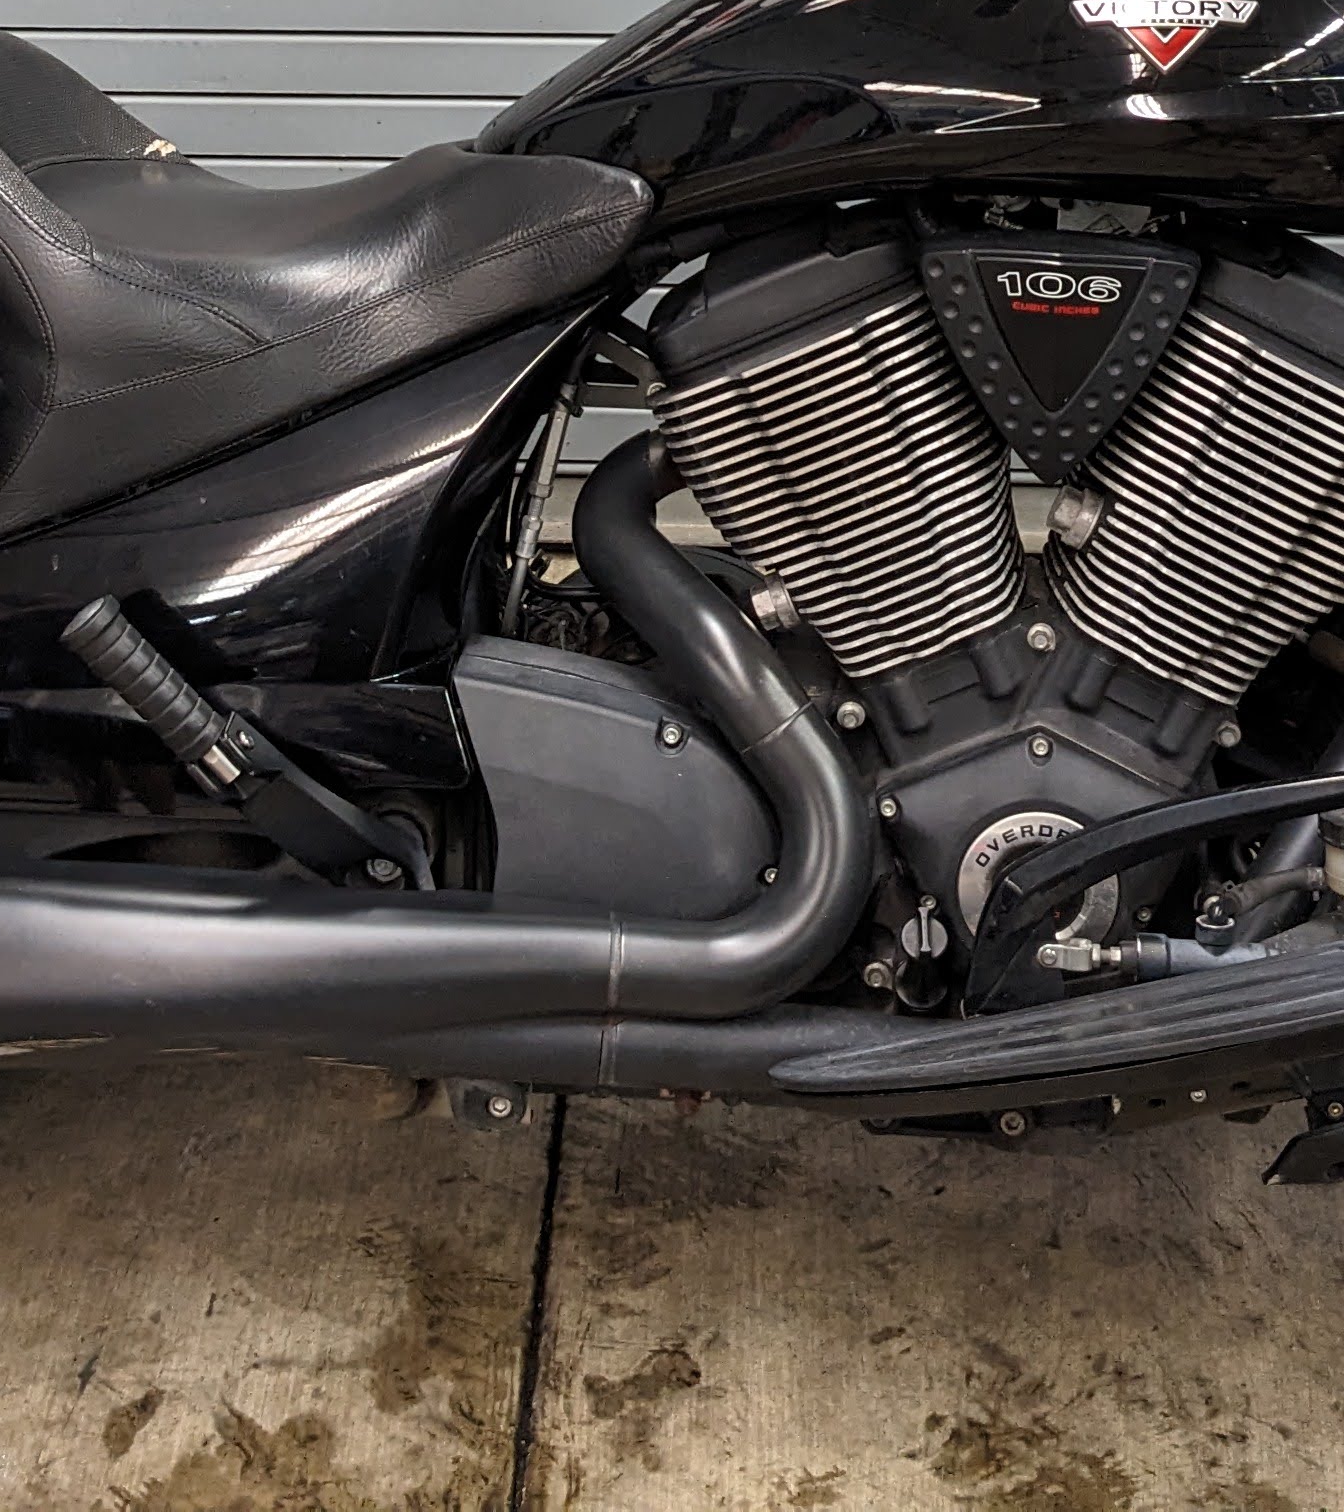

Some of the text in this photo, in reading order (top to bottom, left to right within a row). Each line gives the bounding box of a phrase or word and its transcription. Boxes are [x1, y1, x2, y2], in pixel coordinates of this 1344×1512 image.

[1083, 0, 1248, 19] VITORY
[997, 271, 1122, 303] 106
[1011, 300, 1050, 314] CUBIC
